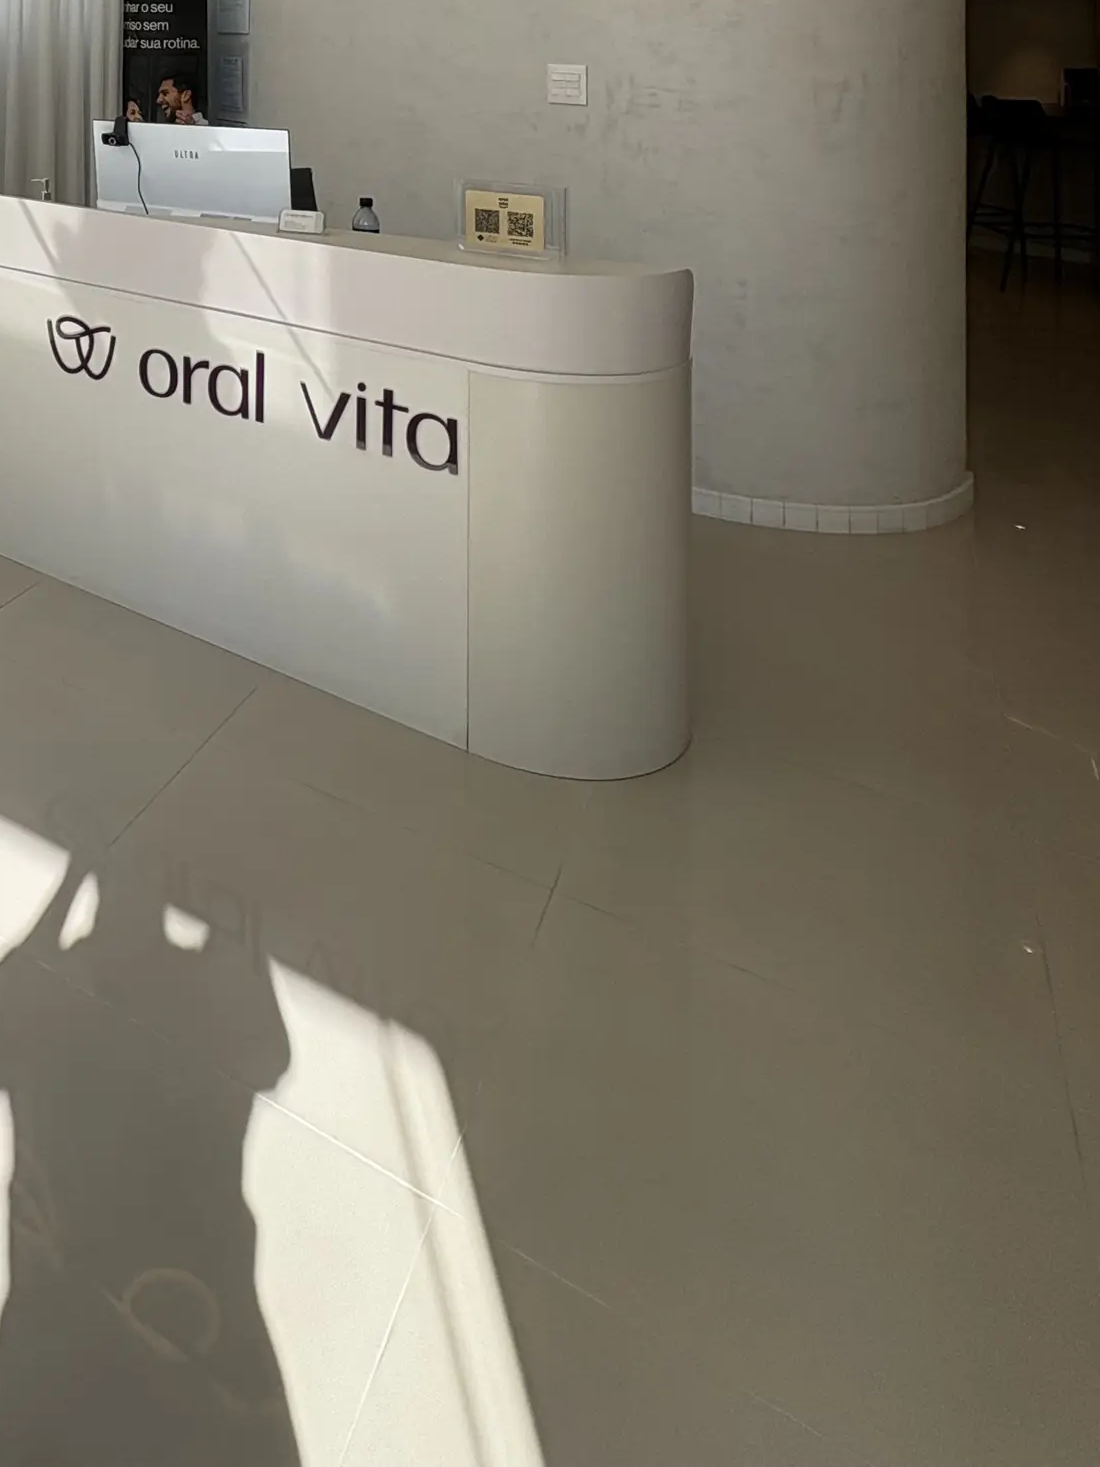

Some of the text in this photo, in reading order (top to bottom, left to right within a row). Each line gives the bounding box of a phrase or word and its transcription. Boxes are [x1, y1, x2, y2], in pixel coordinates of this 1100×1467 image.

[140, 3, 149, 13] o
[150, 3, 173, 13] seu
[142, 21, 170, 31] sem
[139, 38, 161, 49] sua
[163, 36, 200, 49] rotina.
[138, 349, 459, 476] oral vita
